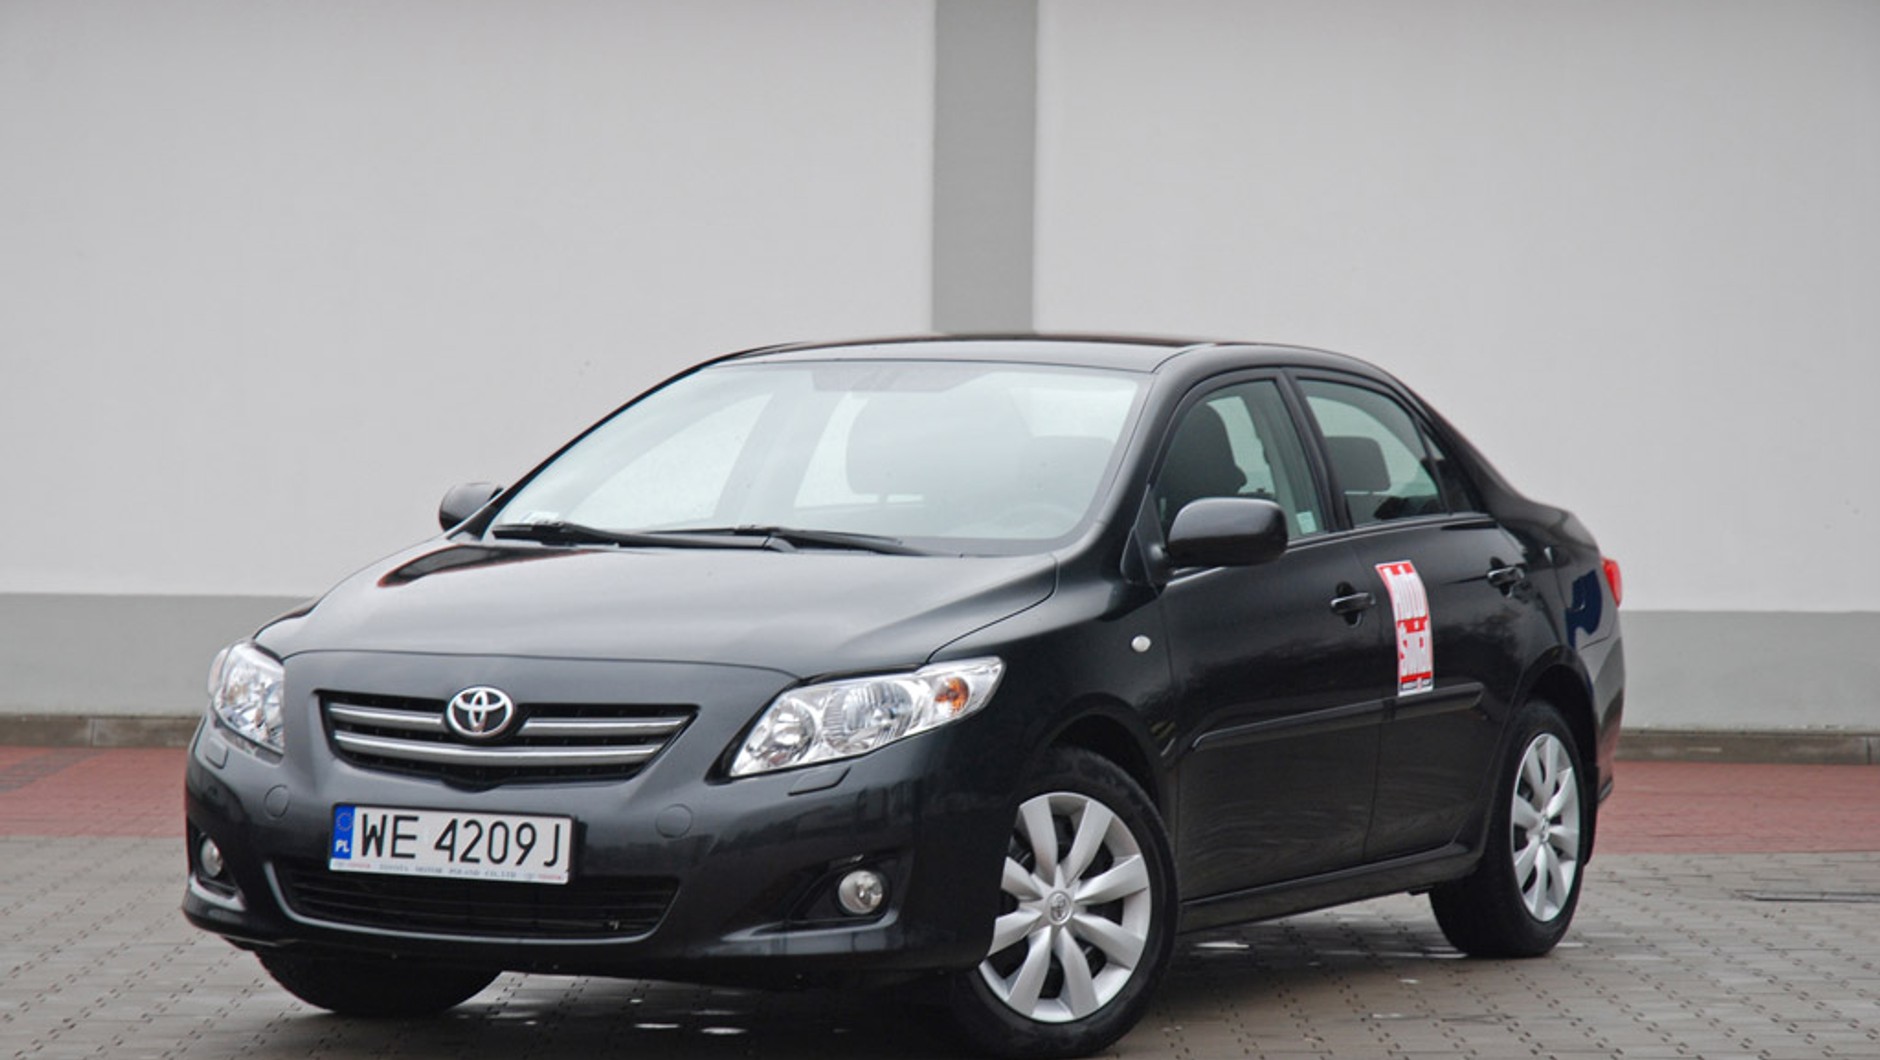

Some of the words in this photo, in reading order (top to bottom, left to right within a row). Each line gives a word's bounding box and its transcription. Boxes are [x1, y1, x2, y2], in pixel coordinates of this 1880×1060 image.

[335, 839, 350, 854] PL
[361, 813, 420, 860] WE
[433, 818, 561, 868] 4209J
